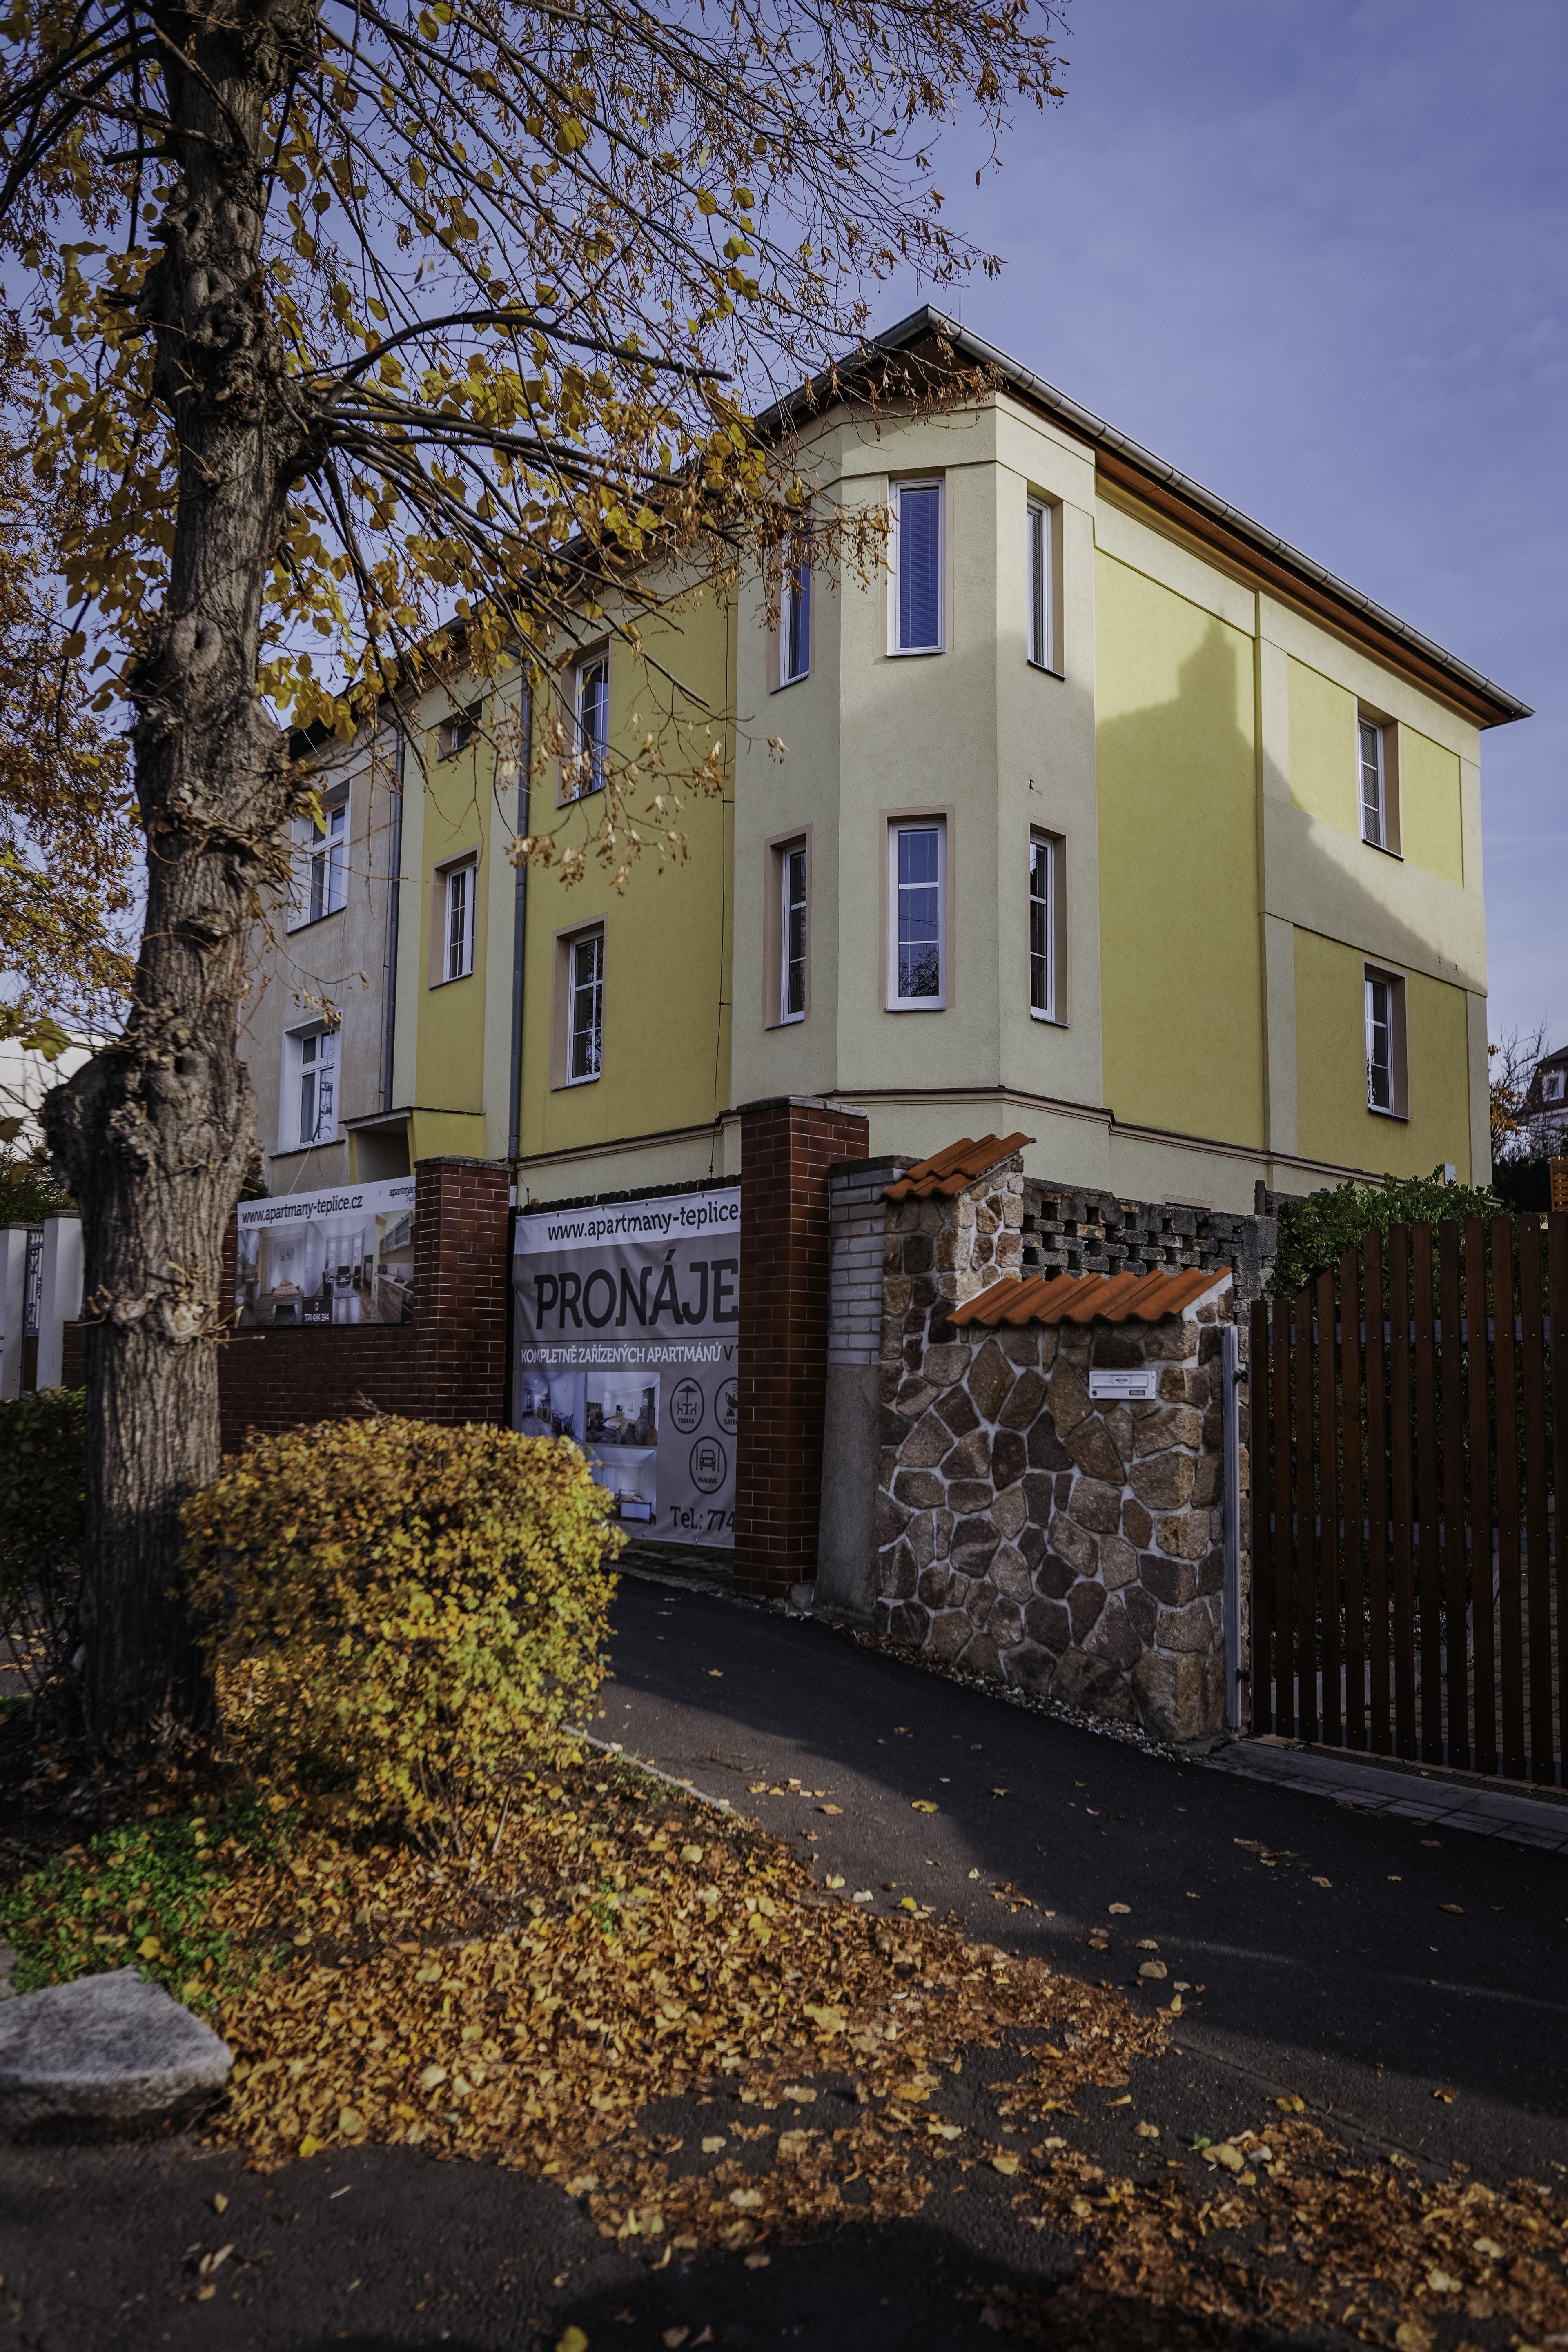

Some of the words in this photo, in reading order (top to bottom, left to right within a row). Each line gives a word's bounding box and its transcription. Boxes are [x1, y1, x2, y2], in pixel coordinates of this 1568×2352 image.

[242, 1195, 363, 1224] www.apartmany-teplice.cz
[534, 1248, 738, 1330] PRONÁJE
[321, 1313, 330, 1321] 394
[521, 1345, 577, 1363] KOMPLETNĚ
[578, 1344, 645, 1363] ZAŘÍZENÝCH
[647, 1341, 722, 1362] APARTMÁNŮ
[670, 1506, 703, 1530] Tel.:
[707, 1509, 735, 1533] 774
